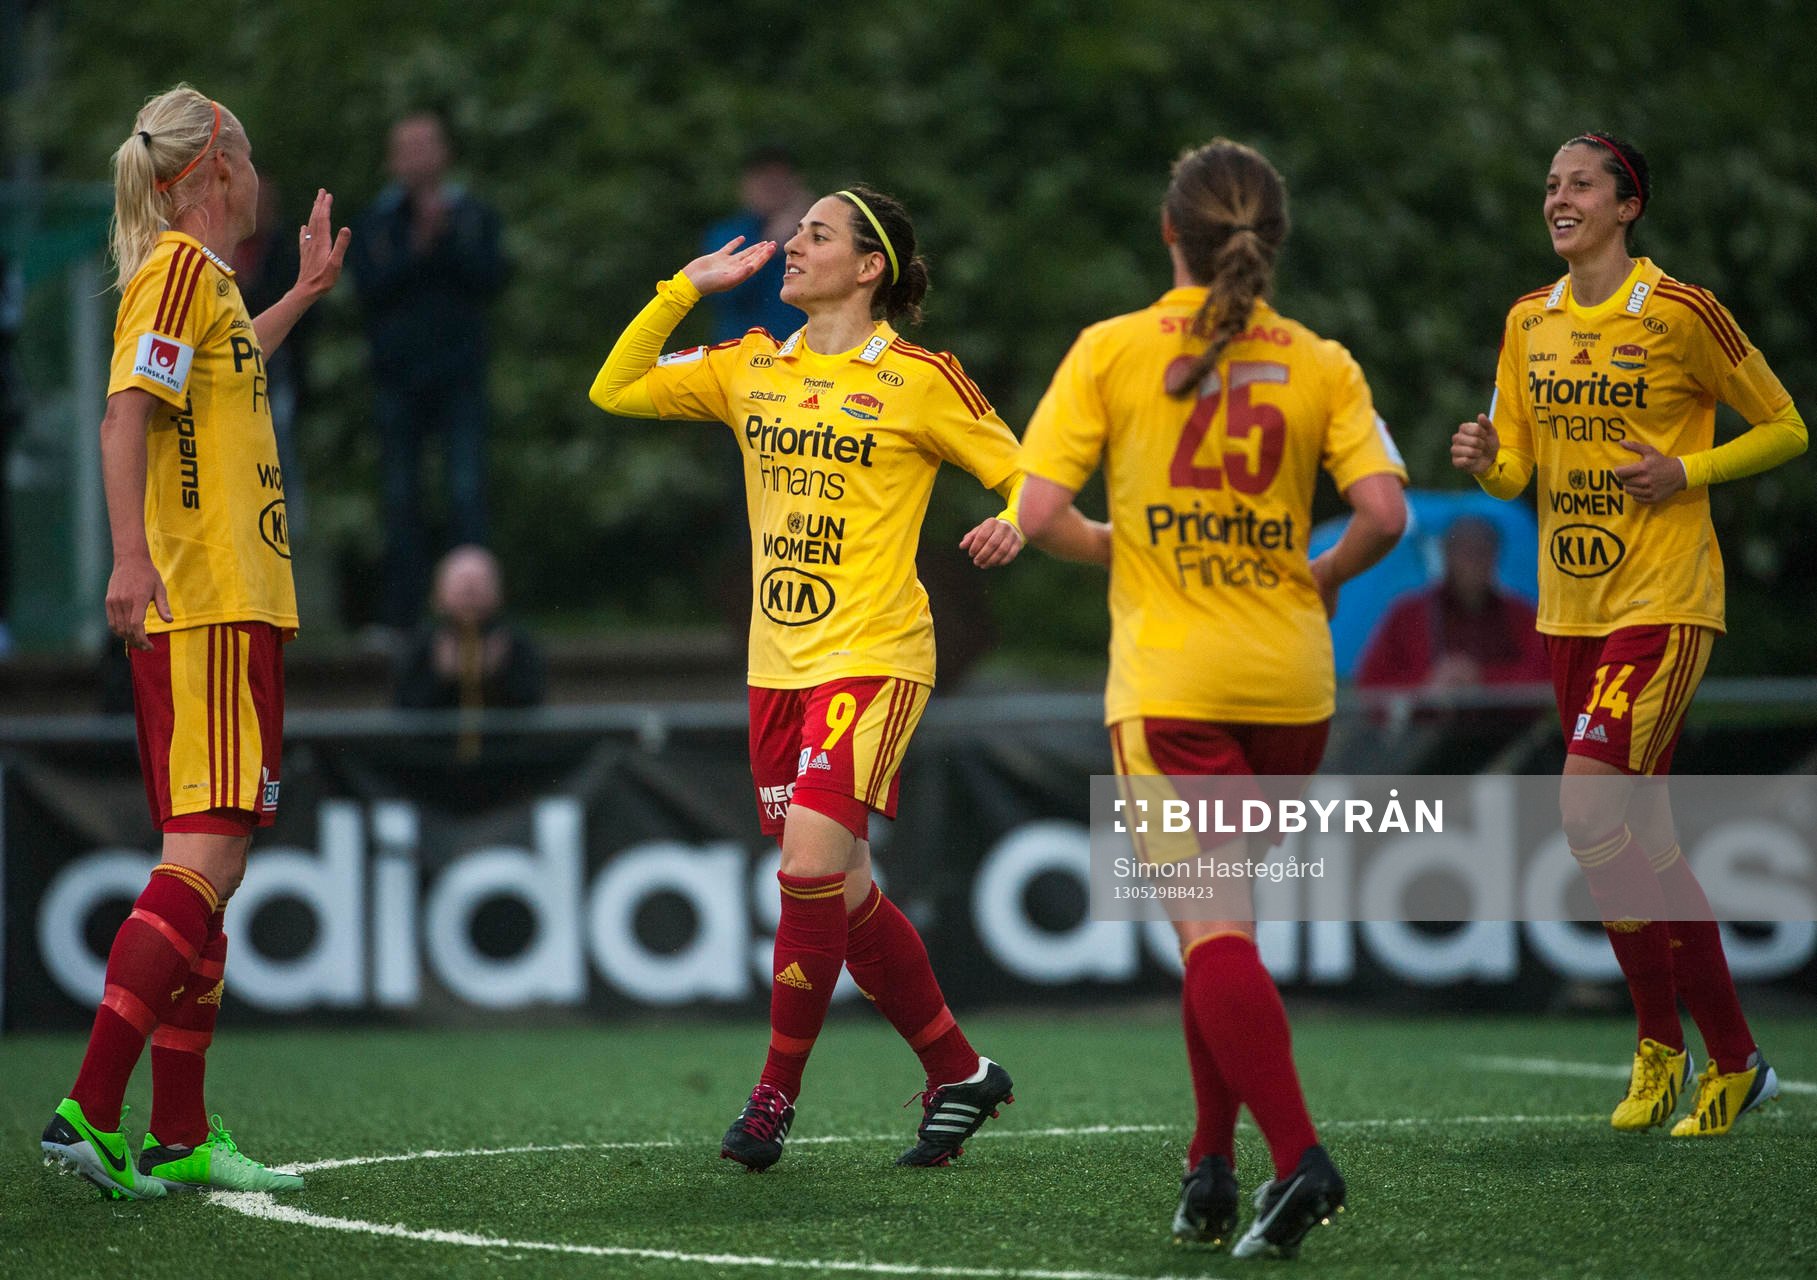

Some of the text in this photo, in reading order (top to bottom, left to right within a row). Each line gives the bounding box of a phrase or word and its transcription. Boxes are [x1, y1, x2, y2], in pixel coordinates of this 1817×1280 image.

[749, 390, 787, 403] stadium
[803, 377, 835, 389] Prioritet
[746, 415, 877, 468] Prioritet
[1164, 354, 1290, 496] 25
[1534, 405, 1627, 443] Finans
[760, 454, 846, 500] Finans
[1588, 470, 1624, 492] UN
[806, 513, 846, 540] UN
[1146, 500, 1294, 551] Prioritet
[763, 532, 842, 565] WOMEN
[1557, 536, 1610, 566] KIA
[768, 578, 819, 615] KIA
[1586, 664, 1636, 719] 14
[821, 692, 857, 750] 9
[808, 762, 831, 770] adidas
[775, 974, 814, 991] adidas
